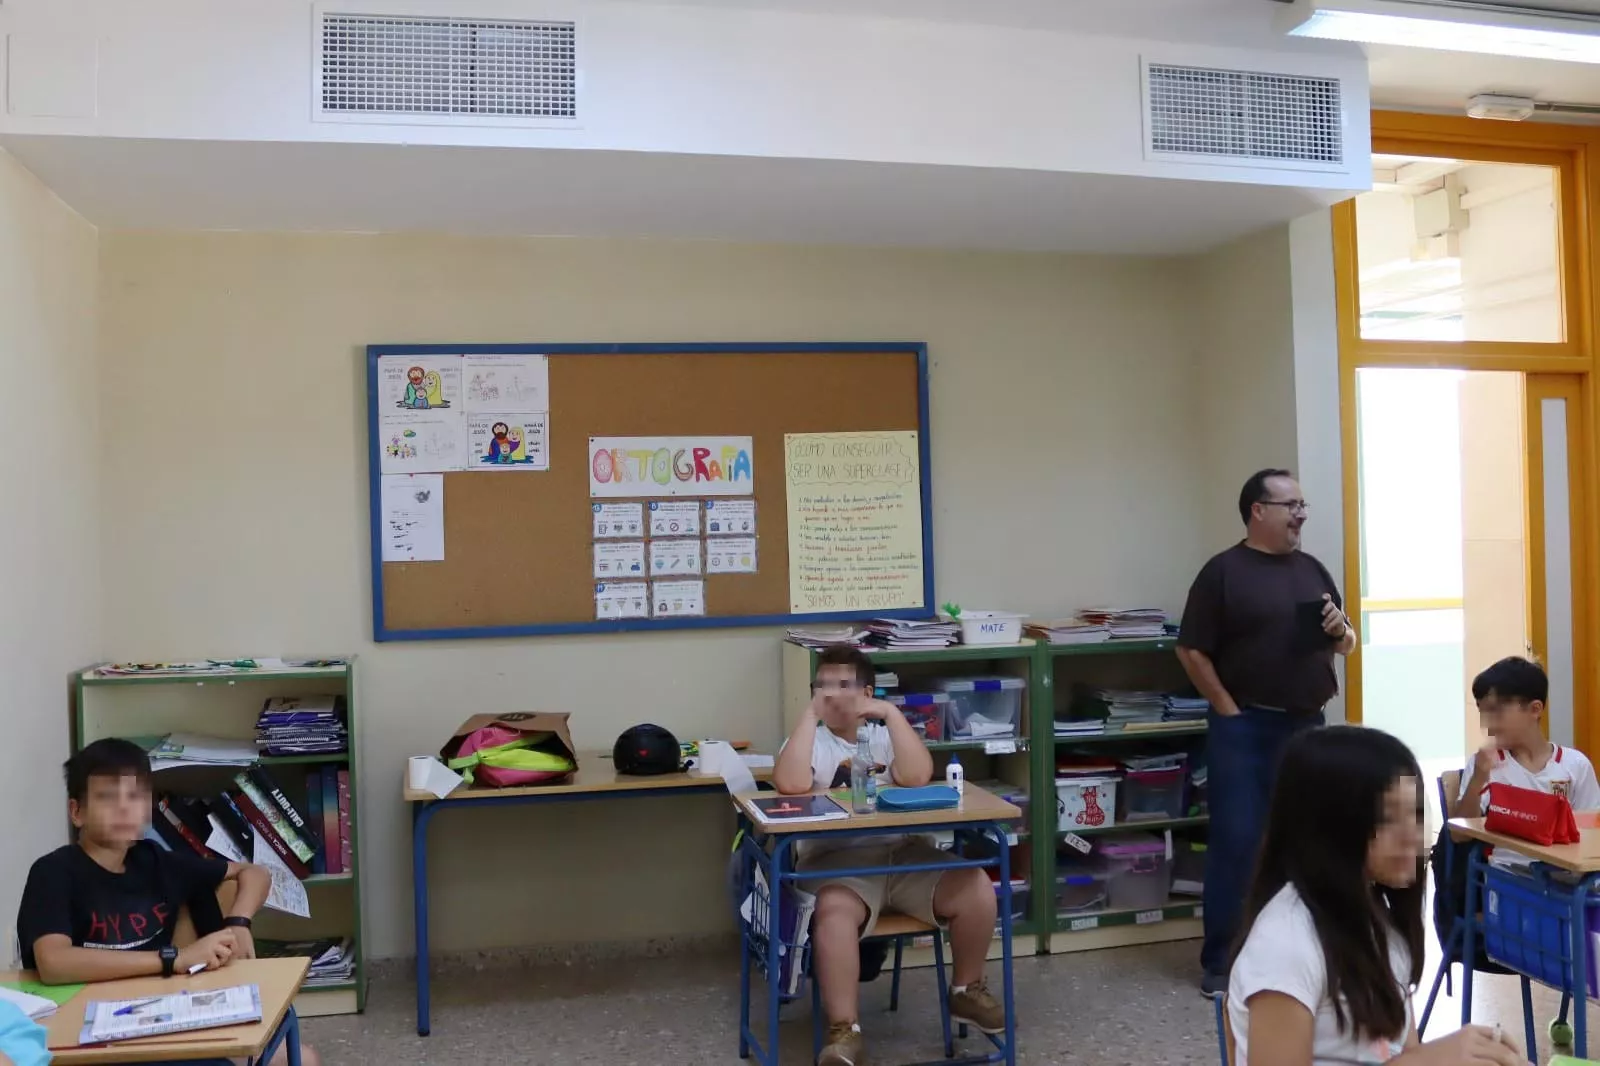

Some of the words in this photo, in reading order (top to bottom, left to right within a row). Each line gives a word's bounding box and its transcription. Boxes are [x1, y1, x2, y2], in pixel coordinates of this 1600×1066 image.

[833, 441, 894, 458] CONSEGUIR
[817, 463, 836, 479] UNA
[846, 594, 860, 608] UN
[980, 622, 1007, 633] MATE
